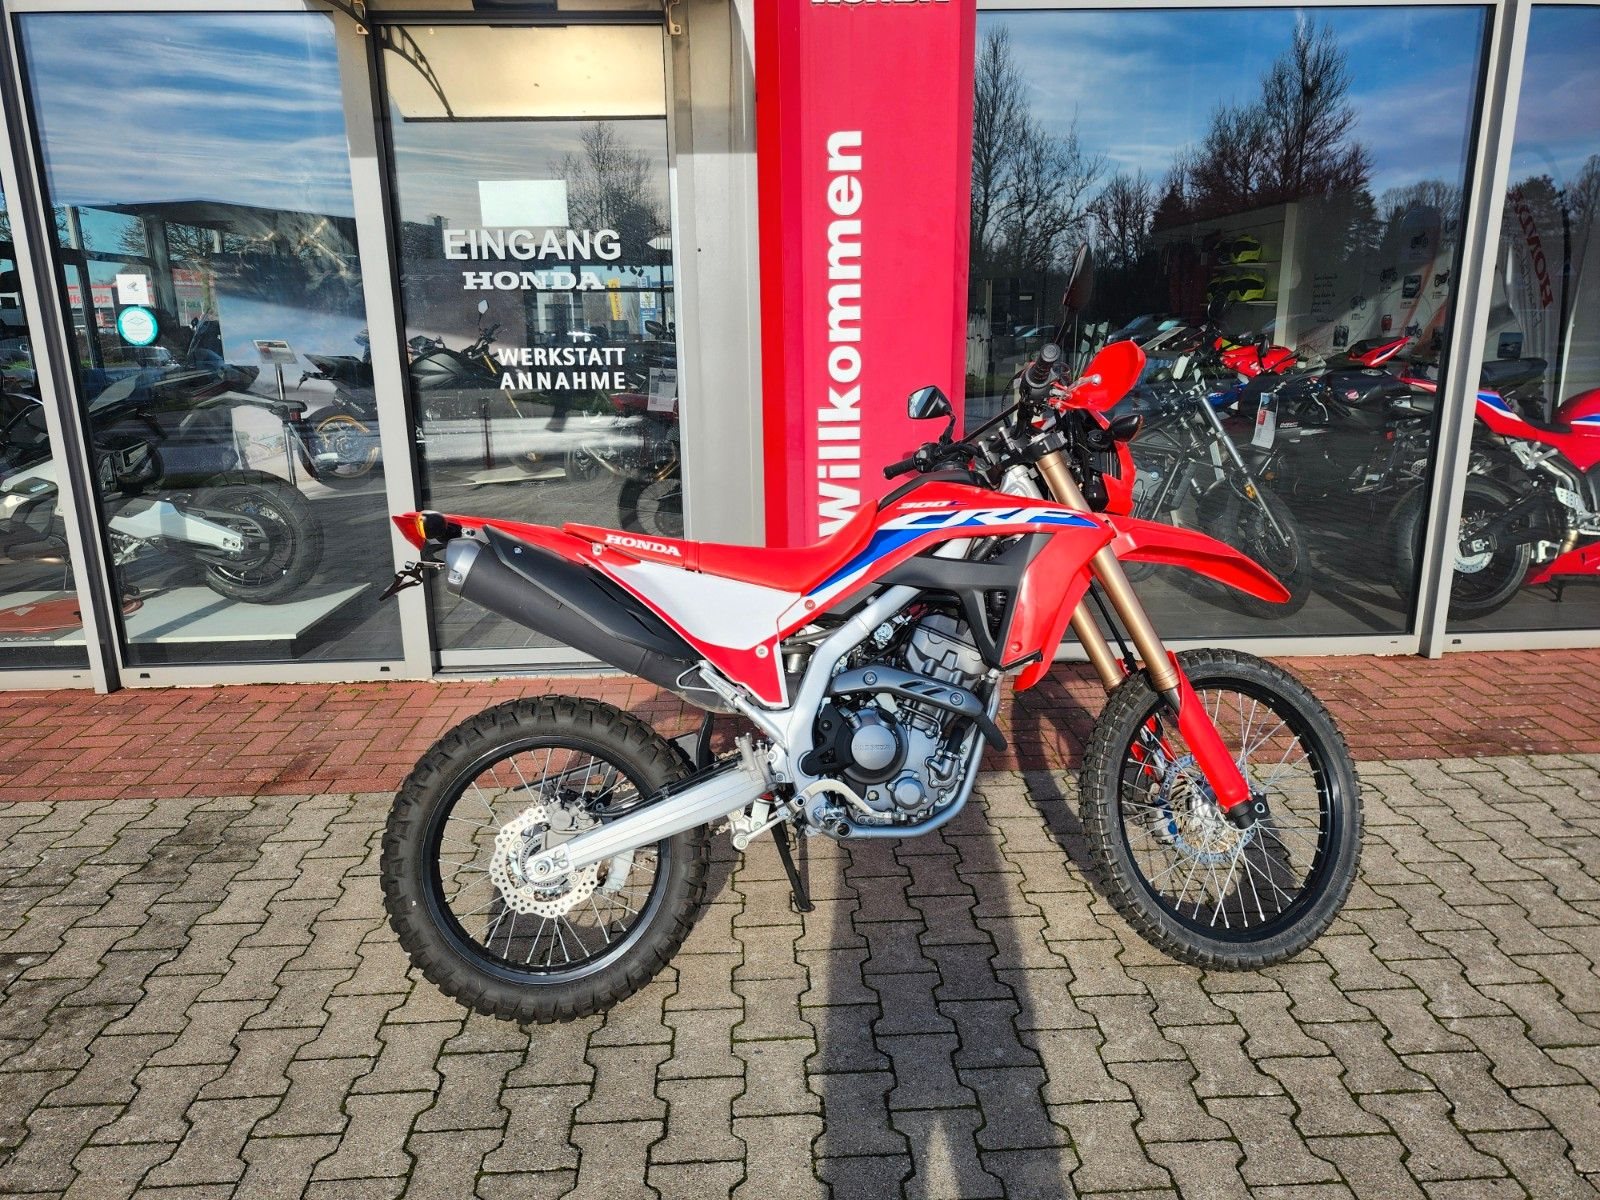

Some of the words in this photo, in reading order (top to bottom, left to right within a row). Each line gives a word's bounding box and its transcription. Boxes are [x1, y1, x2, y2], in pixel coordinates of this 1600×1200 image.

[444, 229, 621, 260] EINGANG
[463, 272, 605, 290] HONDA
[818, 130, 862, 538] Willkommen
[498, 348, 625, 366] WERKSTATT
[500, 372, 626, 390] ANNAHME
[877, 507, 1086, 530] CRF
[605, 534, 681, 556] HONDA
